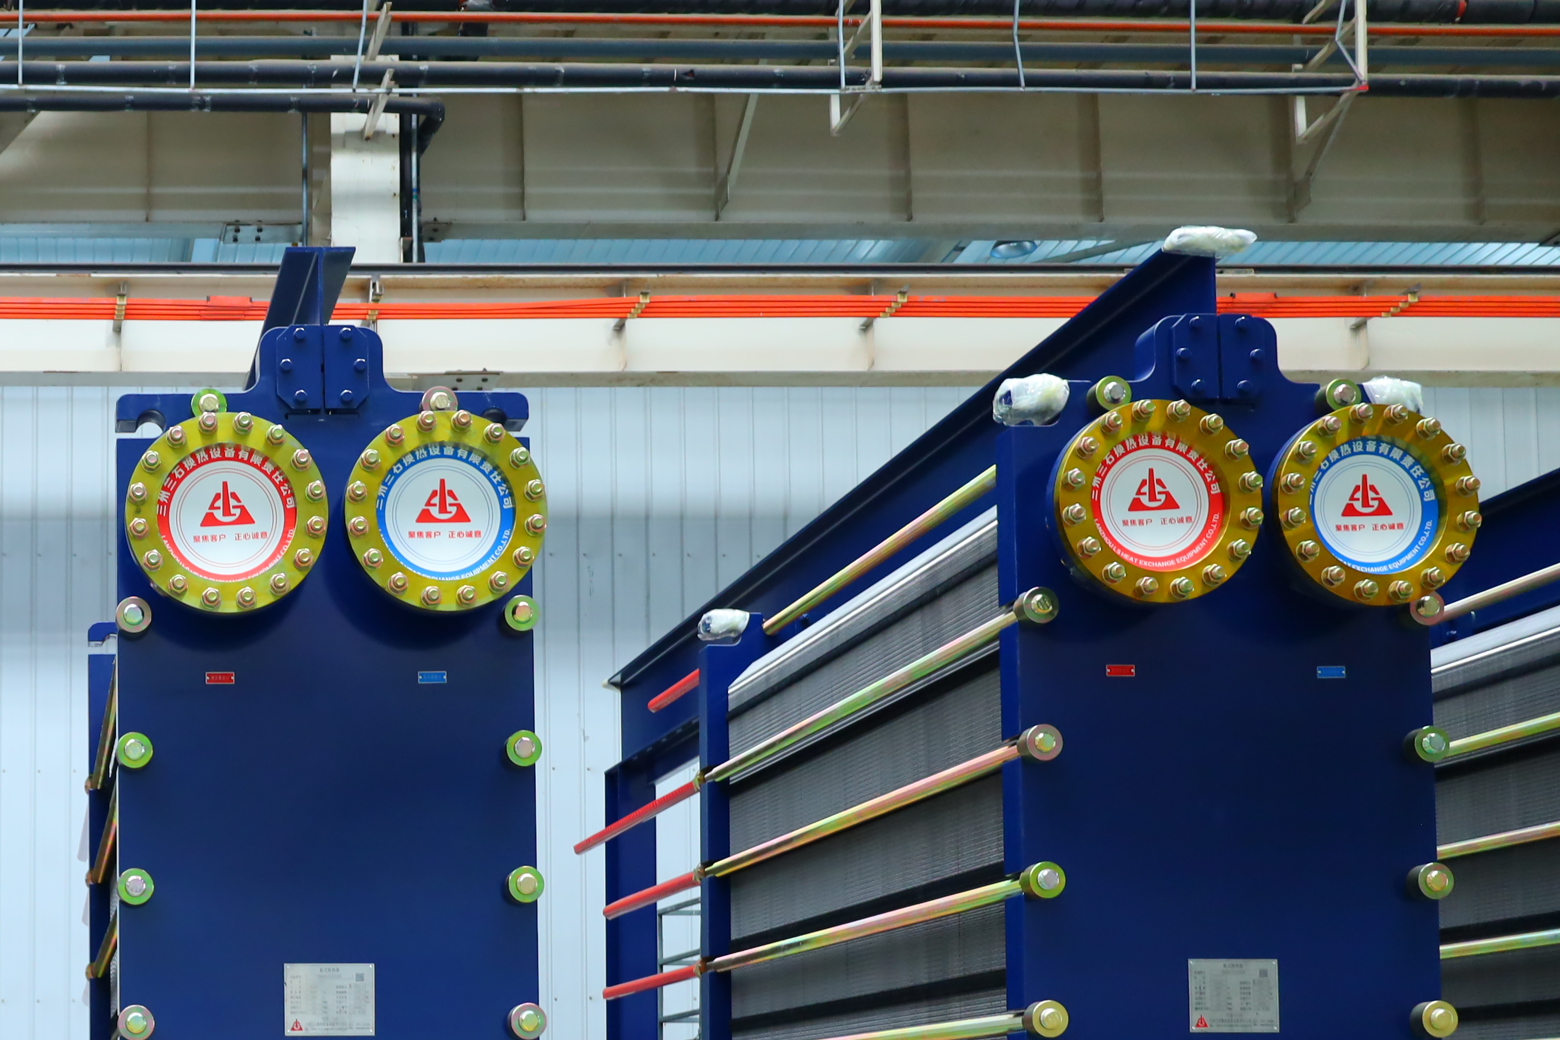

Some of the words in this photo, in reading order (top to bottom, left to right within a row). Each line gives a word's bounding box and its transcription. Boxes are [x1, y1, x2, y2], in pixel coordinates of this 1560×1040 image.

[1122, 519, 1152, 527] 聚焦客户
[1160, 517, 1194, 525] 正心诚意
[1372, 523, 1405, 531] 正心诚意
[193, 534, 226, 543] 聚焦客户
[235, 532, 268, 541] 正心诚意
[1093, 517, 1114, 548] LANZHOU
[1119, 551, 1138, 564] HEAT
[1138, 558, 1175, 567] EXCHANGE
[1175, 536, 1209, 564] EQUIPMENT
[1387, 543, 1421, 570] EQUIPMENT
[460, 553, 497, 580] EQUIPMENT
